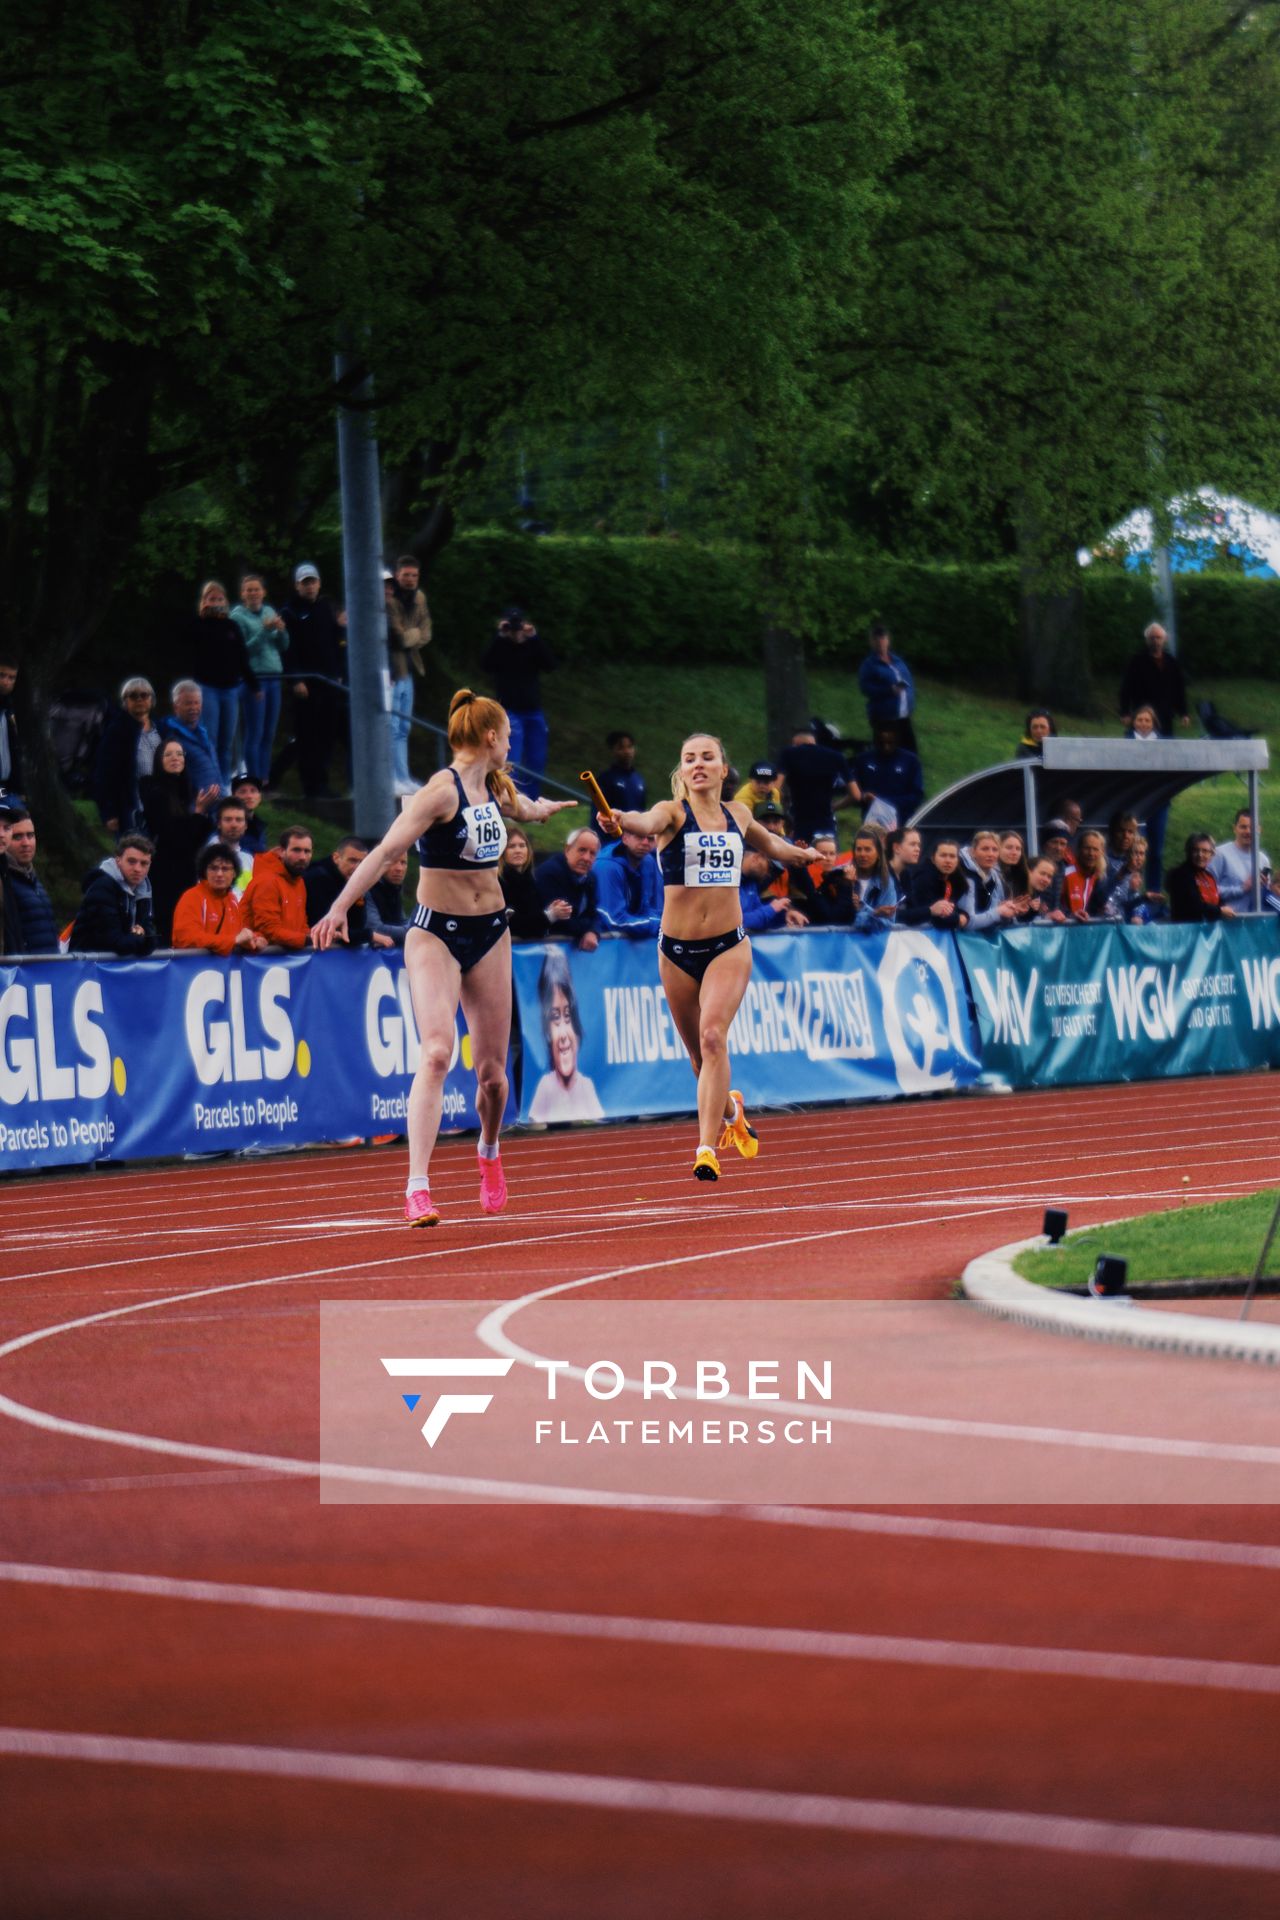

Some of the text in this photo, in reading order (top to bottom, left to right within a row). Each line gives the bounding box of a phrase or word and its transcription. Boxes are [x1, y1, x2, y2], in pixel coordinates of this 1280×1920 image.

[474, 807, 493, 821] GLS
[475, 821, 501, 845] 166
[697, 849, 735, 869] 159
[727, 980, 805, 1056] AUCHEN
[1106, 963, 1176, 1041] WGV
[366, 966, 474, 1078] GL.
[194, 1095, 299, 1132] Parcels to People
[443, 1087, 467, 1122] ople
[0, 1114, 115, 1152] Parcels to People
